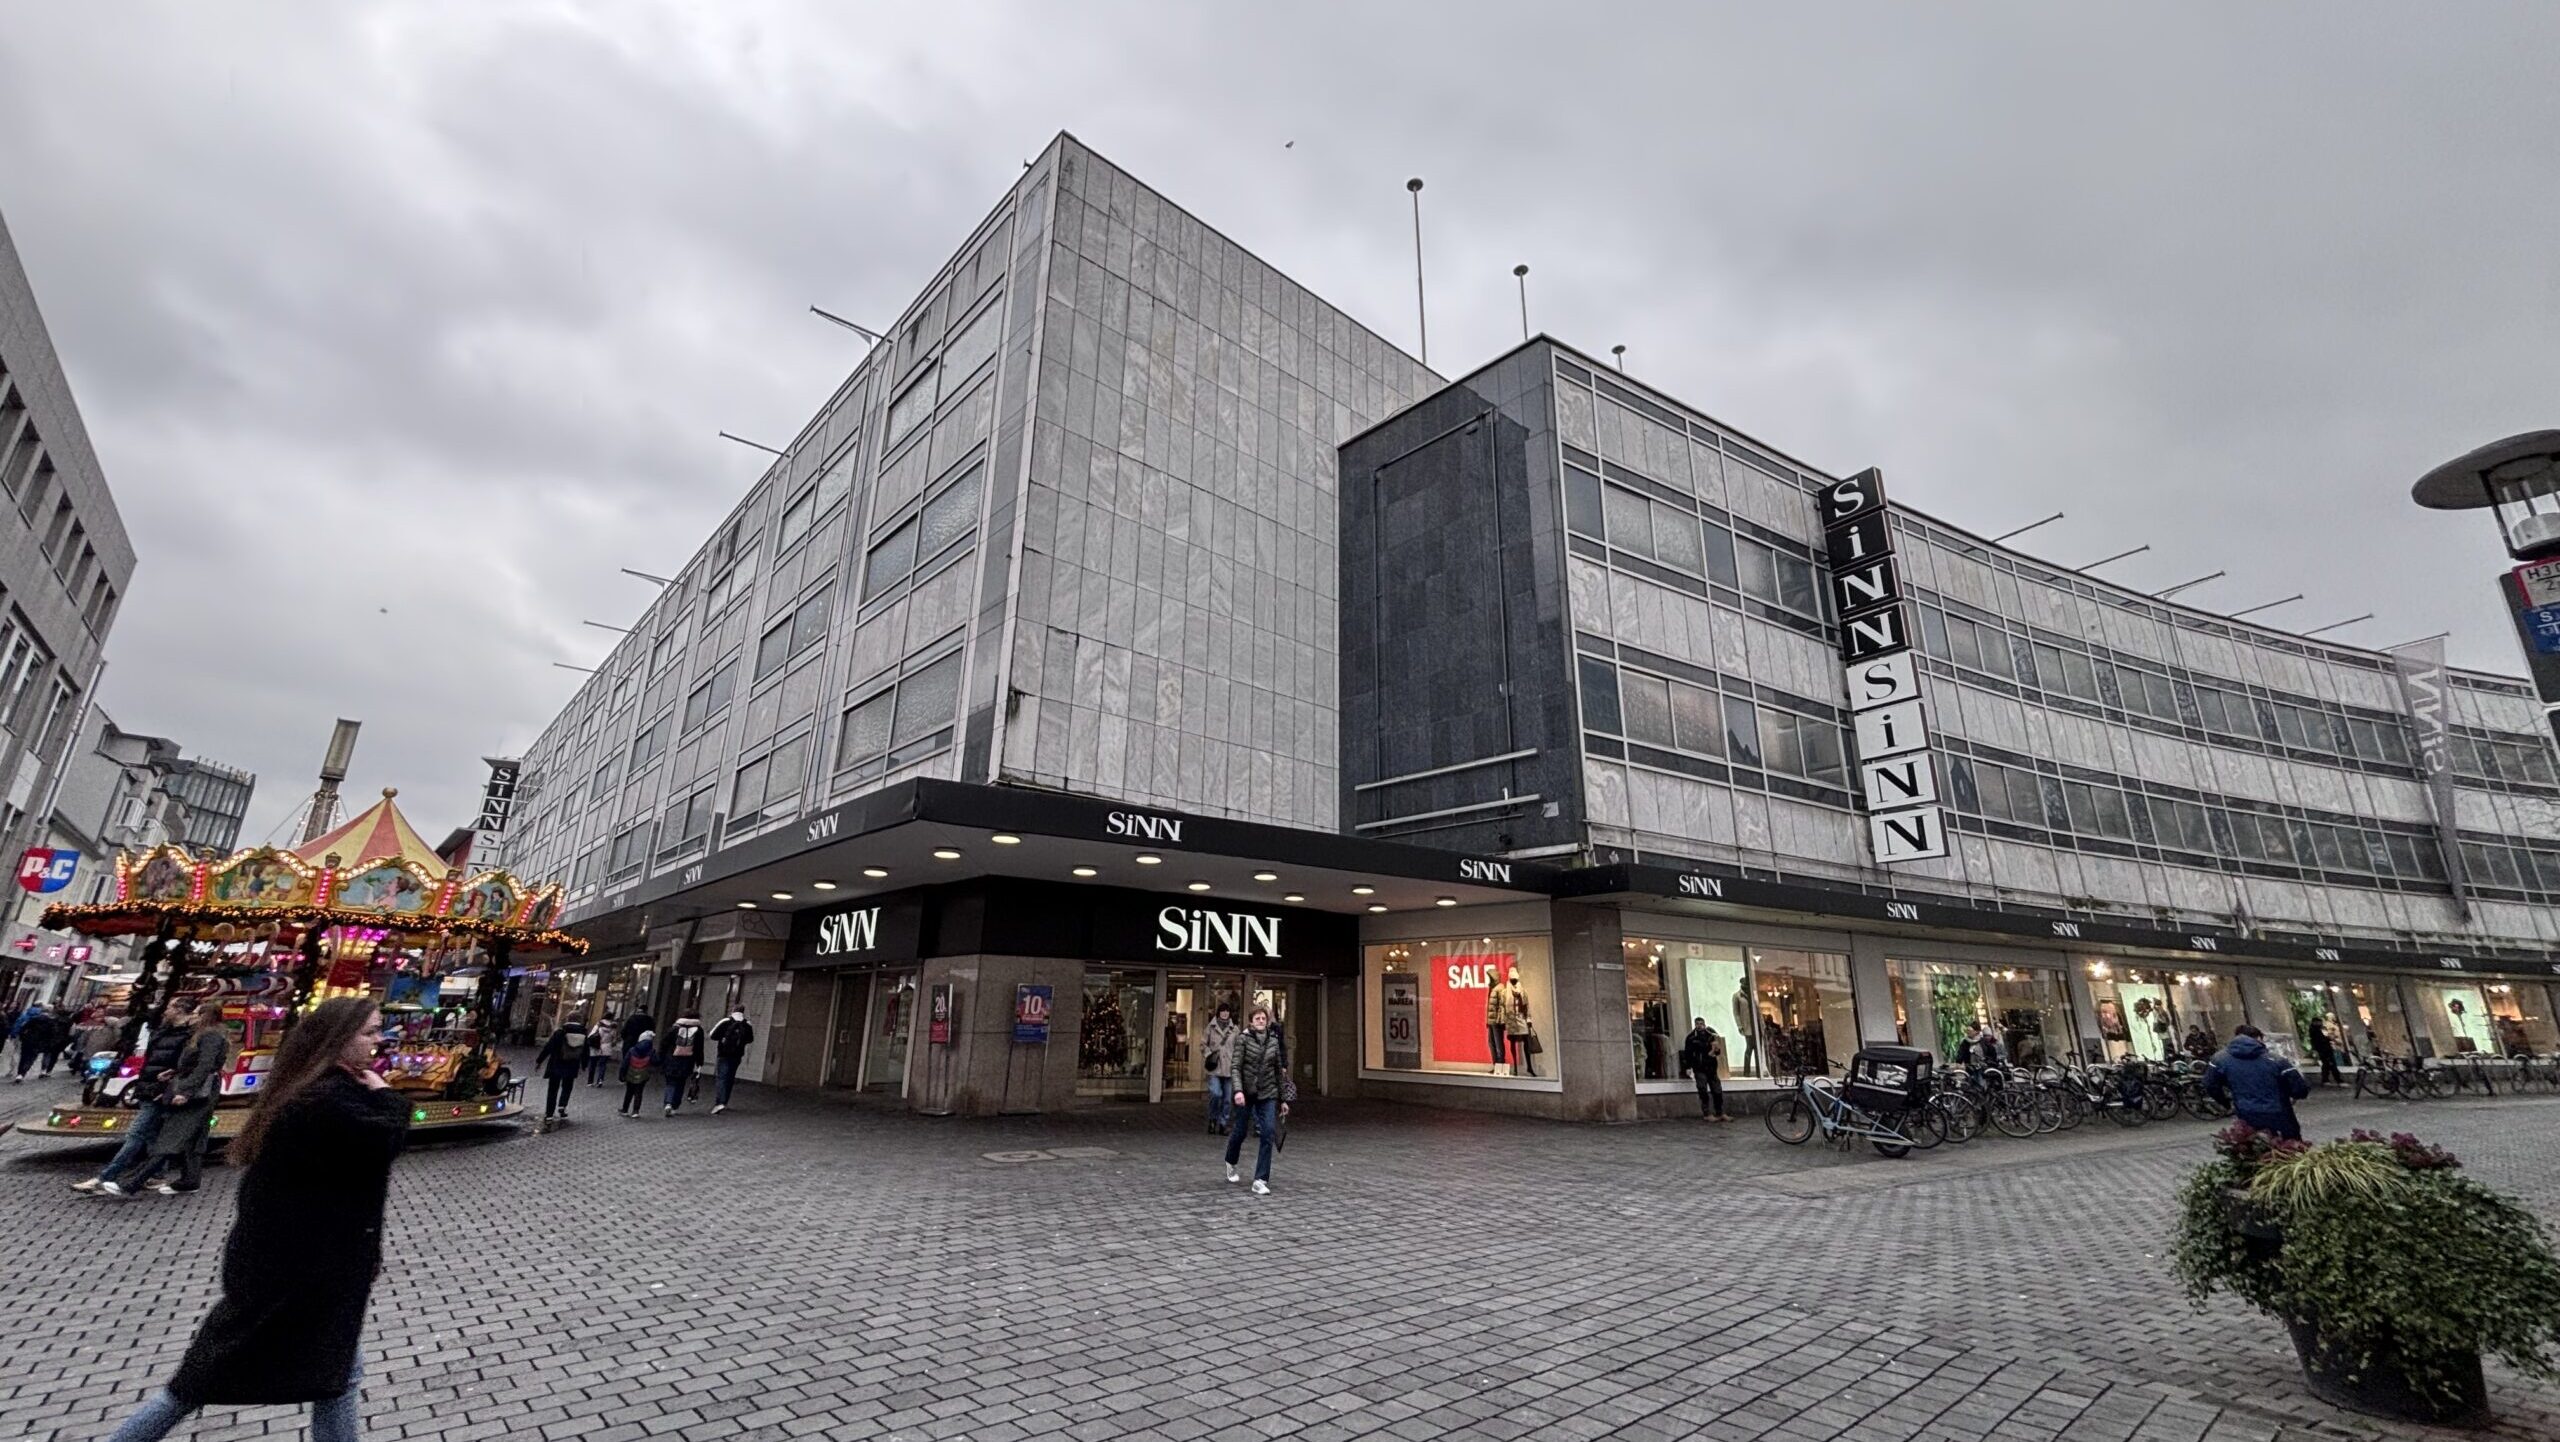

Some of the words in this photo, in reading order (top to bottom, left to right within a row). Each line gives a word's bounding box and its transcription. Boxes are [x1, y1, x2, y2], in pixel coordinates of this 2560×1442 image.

[1833, 478, 1897, 658] SiNN
[1864, 663, 1934, 857] SiNN
[806, 813, 839, 842] SiNN
[1107, 811, 1183, 842] SiNN
[20, 856, 75, 881] P&C
[472, 833, 496, 877] SiN
[1460, 858, 1512, 884] SiNN
[1679, 874, 1723, 897] SiNN
[1886, 901, 1919, 921] SiNN
[817, 907, 881, 956] SiNN
[1156, 906, 1282, 958] SiNN
[2052, 920, 2080, 938] SiNN
[1448, 964, 1496, 989] SALE
[1389, 1017, 1410, 1041] 50
